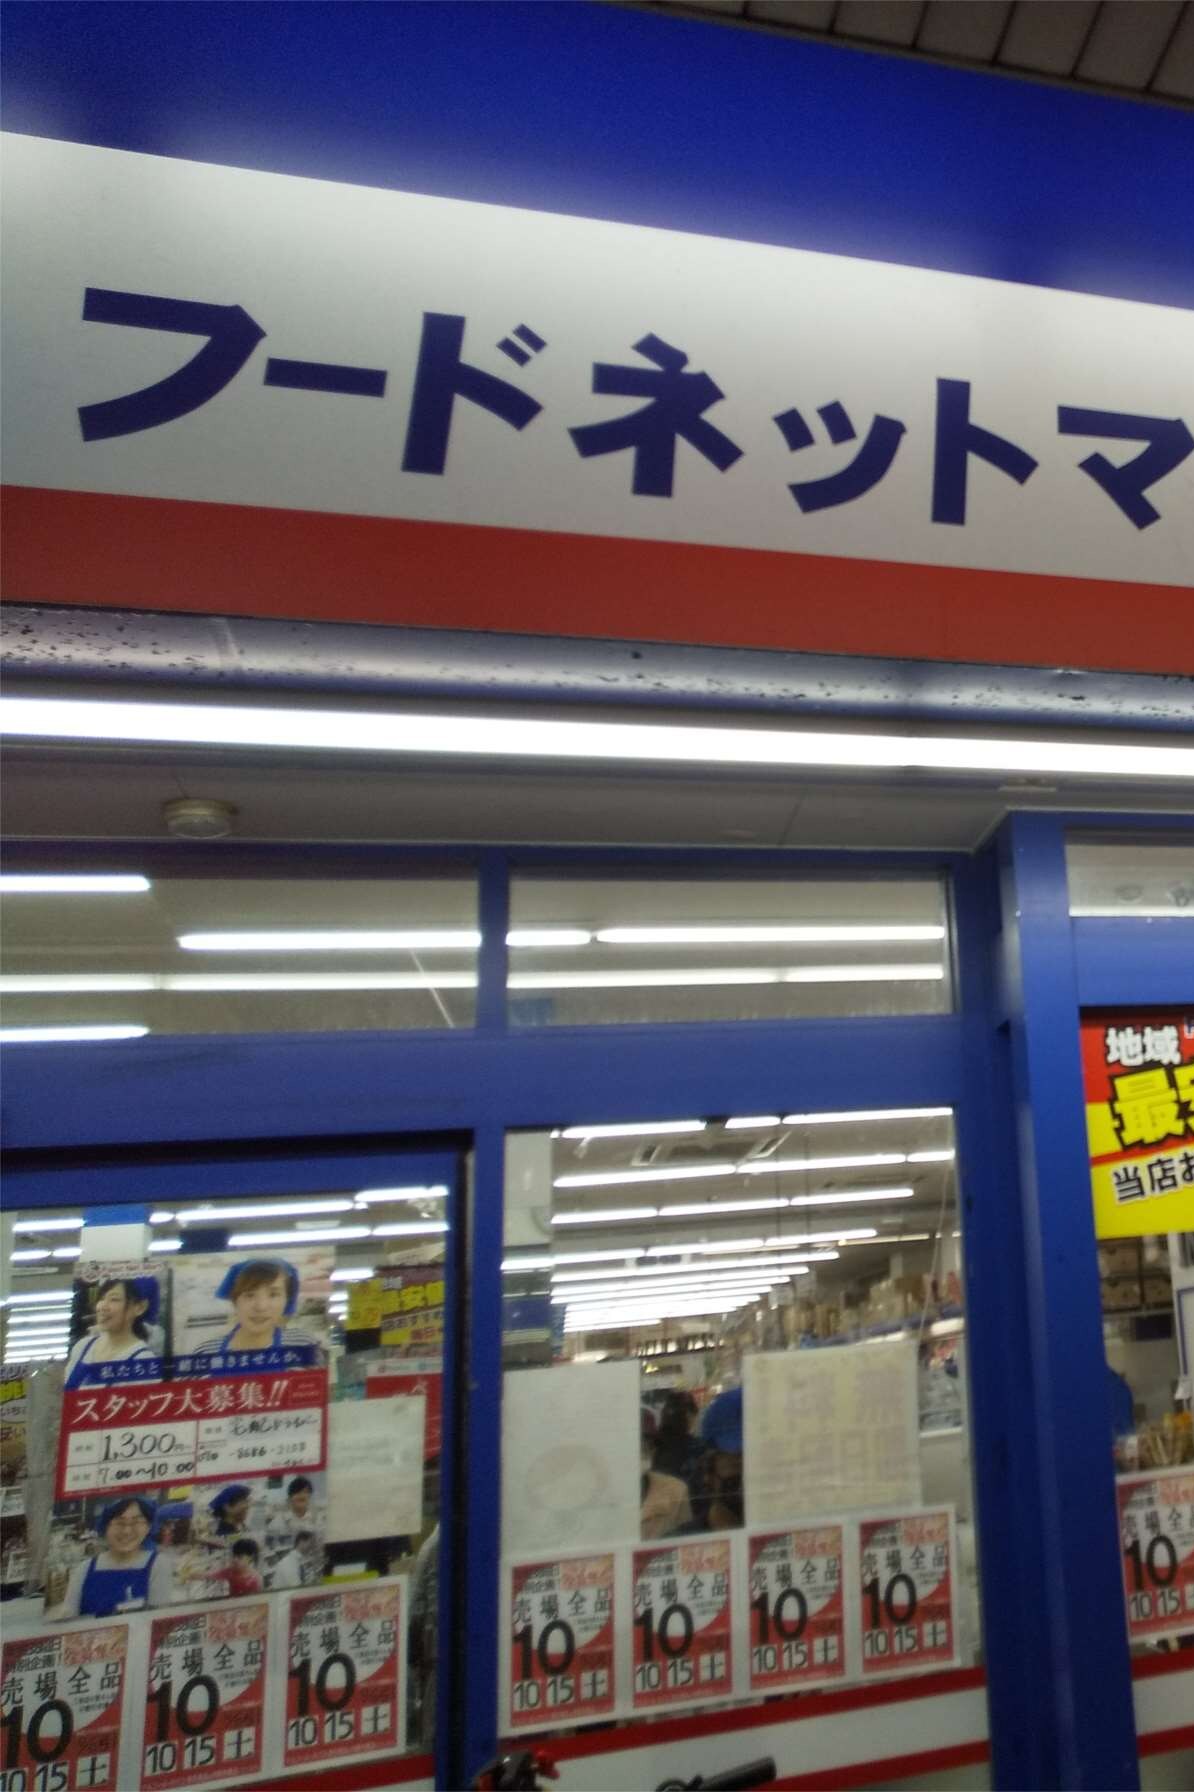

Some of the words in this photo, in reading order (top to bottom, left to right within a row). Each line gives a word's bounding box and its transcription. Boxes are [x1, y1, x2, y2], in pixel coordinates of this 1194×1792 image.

[1106, 1025, 1182, 1066] 地域
[513, 1588, 610, 1624] 売場全品
[634, 1573, 727, 1609] 売場全品
[1130, 1593, 1152, 1617] 10
[1160, 1589, 1180, 1615] 15
[289, 1620, 396, 1658] 売場全品
[866, 1631, 888, 1656] 10
[895, 1626, 918, 1652] 15
[150, 1639, 262, 1683] 売場全品
[636, 1664, 661, 1689] 10
[668, 1659, 693, 1685] 15
[754, 1647, 777, 1673] 10
[783, 1642, 807, 1668] 15
[1, 1662, 120, 1706] 売場全品
[514, 1681, 541, 1709] 10
[547, 1675, 574, 1703] 15
[289, 1716, 318, 1746] 10
[325, 1711, 353, 1740] 15
[147, 1743, 176, 1773] 10
[184, 1735, 215, 1766] 15
[0, 1769, 27, 1792] 10
[35, 1760, 68, 1792] 15
